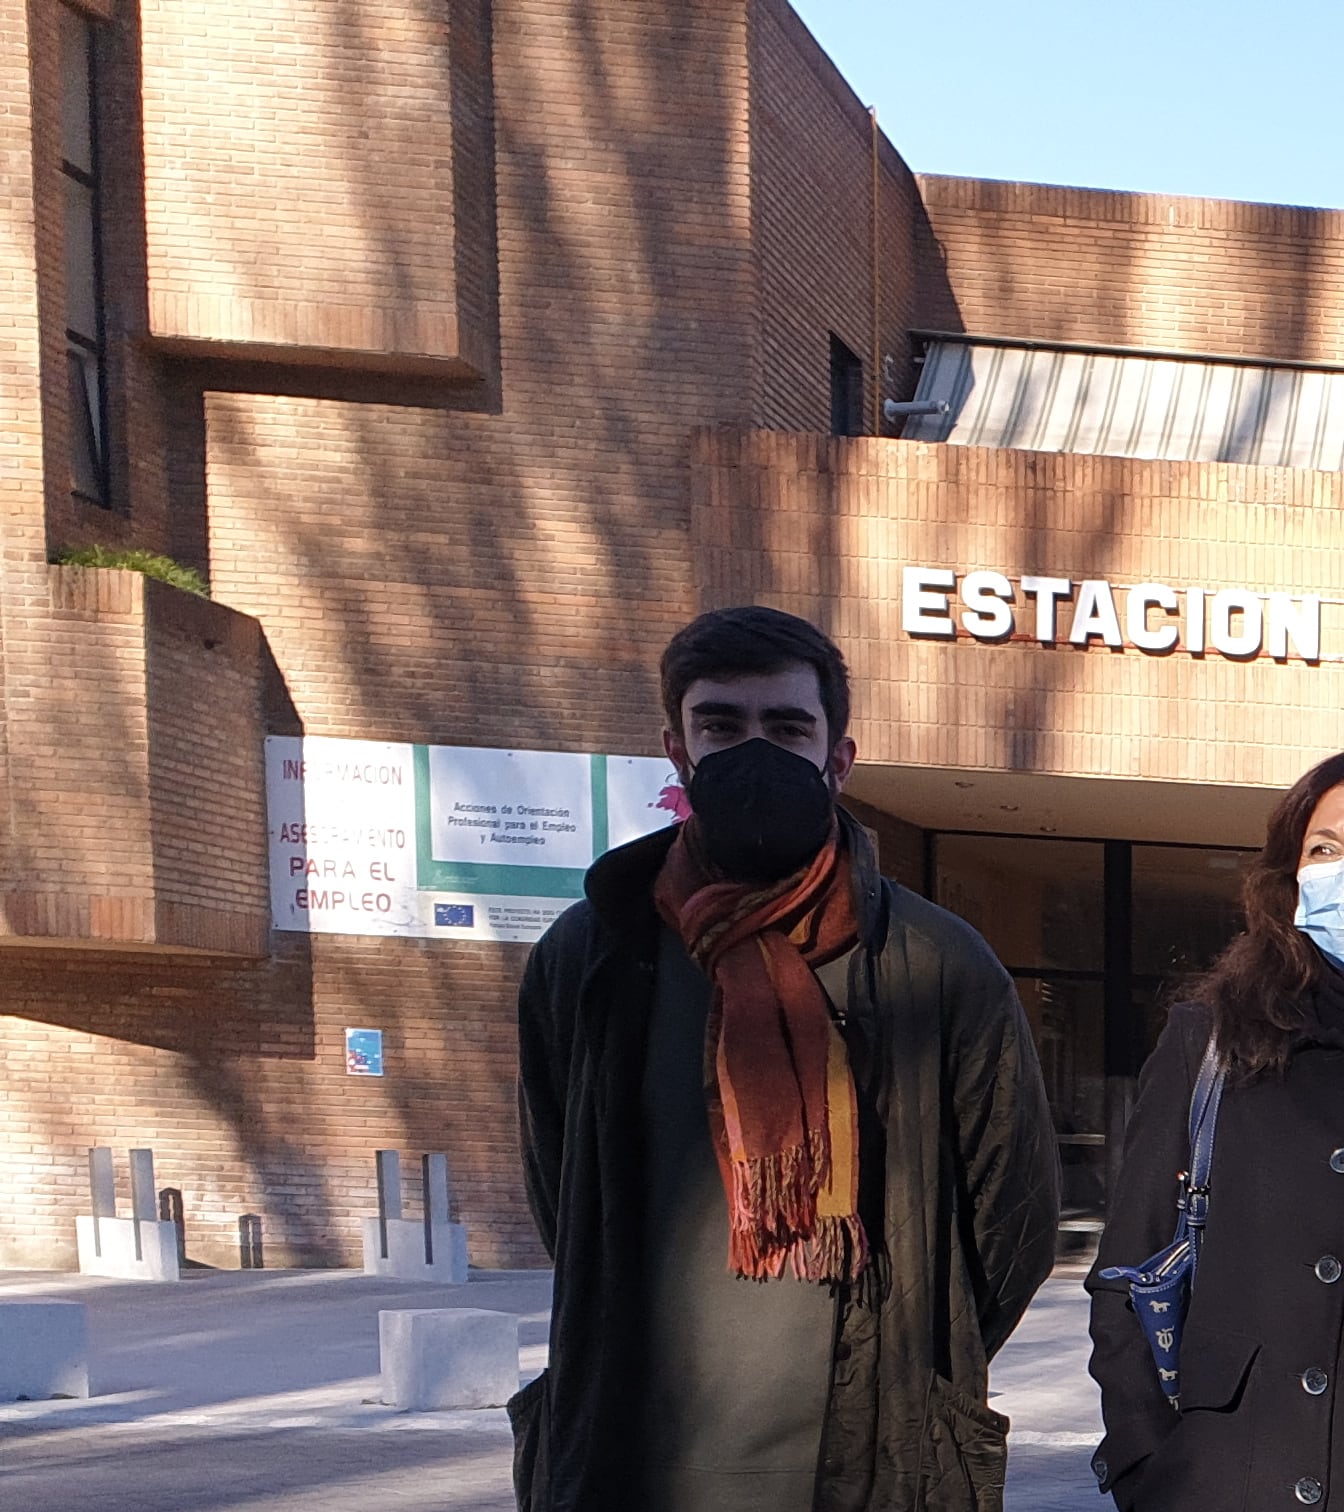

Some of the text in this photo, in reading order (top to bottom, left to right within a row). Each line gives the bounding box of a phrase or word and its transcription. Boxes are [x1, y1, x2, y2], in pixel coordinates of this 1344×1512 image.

[902, 566, 1321, 661] ESTACION
[282, 758, 403, 786] INFMACION
[453, 802, 497, 814] Acciones
[501, 803, 513, 815] de
[447, 815, 577, 833] Profesional para el Empleo
[480, 832, 546, 845] y Autoempleo
[289, 855, 396, 882] PARA EL
[295, 887, 392, 913] EMPLEO
